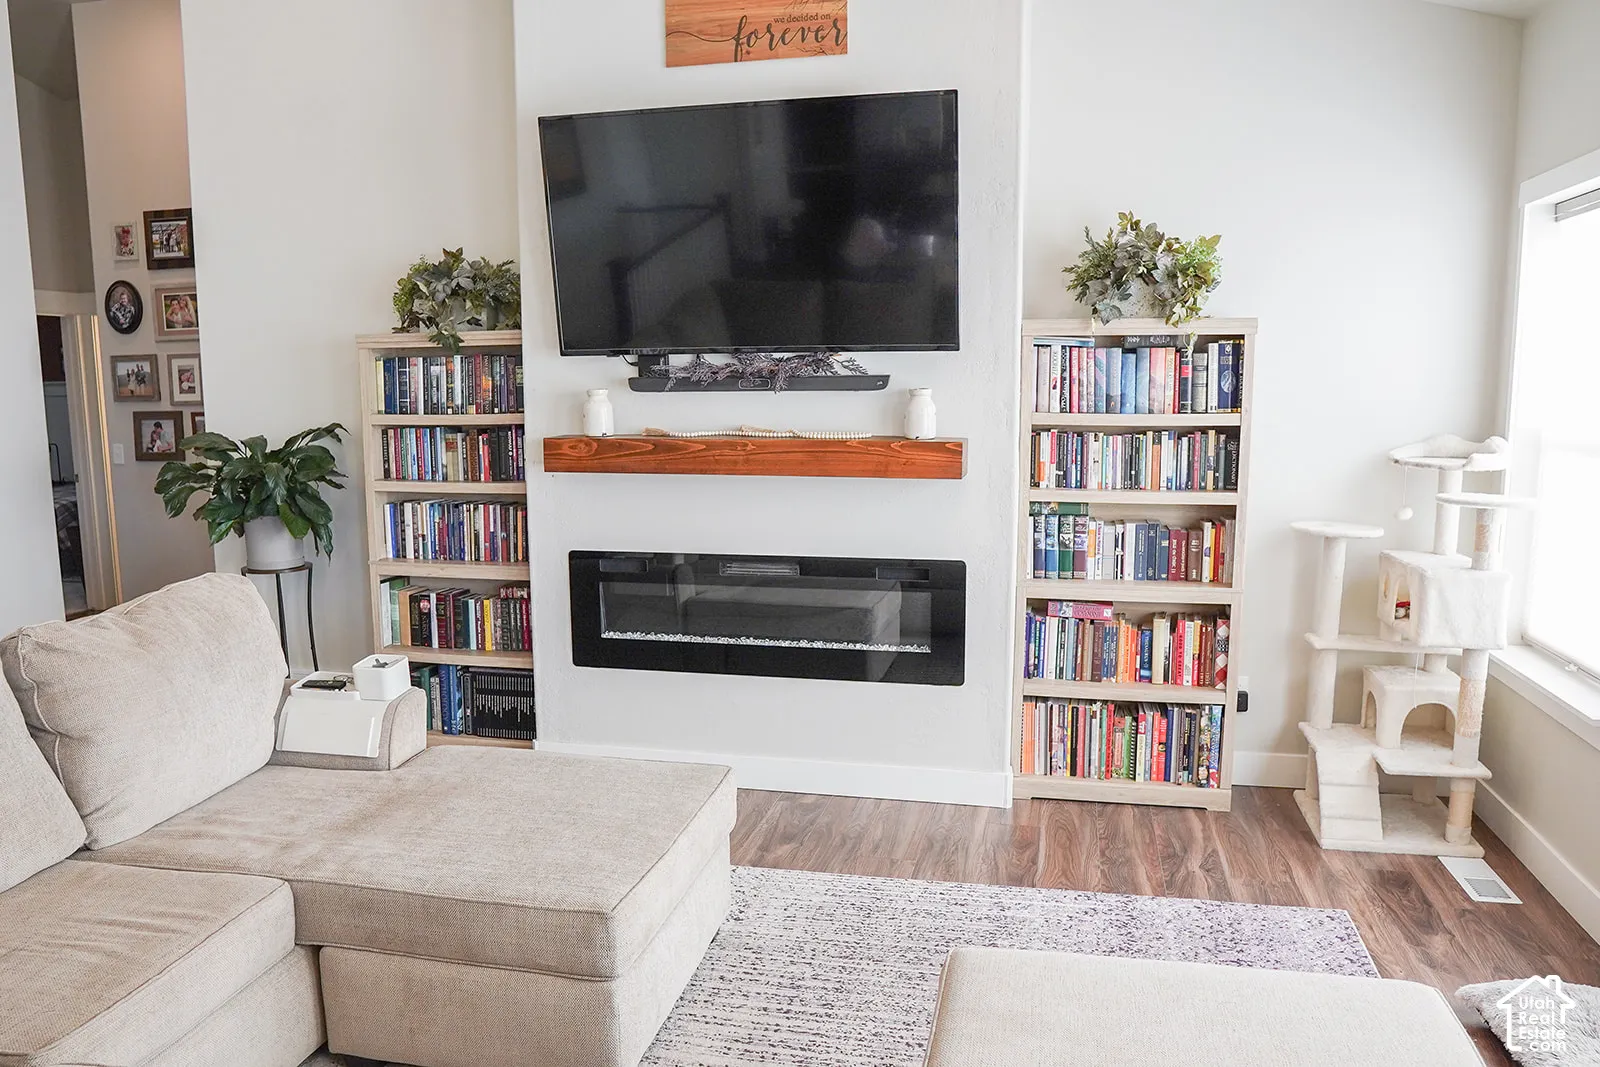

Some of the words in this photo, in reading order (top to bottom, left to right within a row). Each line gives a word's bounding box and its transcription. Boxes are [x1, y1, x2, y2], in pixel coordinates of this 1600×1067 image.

[774, 15, 785, 24] we
[786, 13, 819, 23] decided
[820, 12, 831, 20] on
[733, 15, 848, 62] forever
